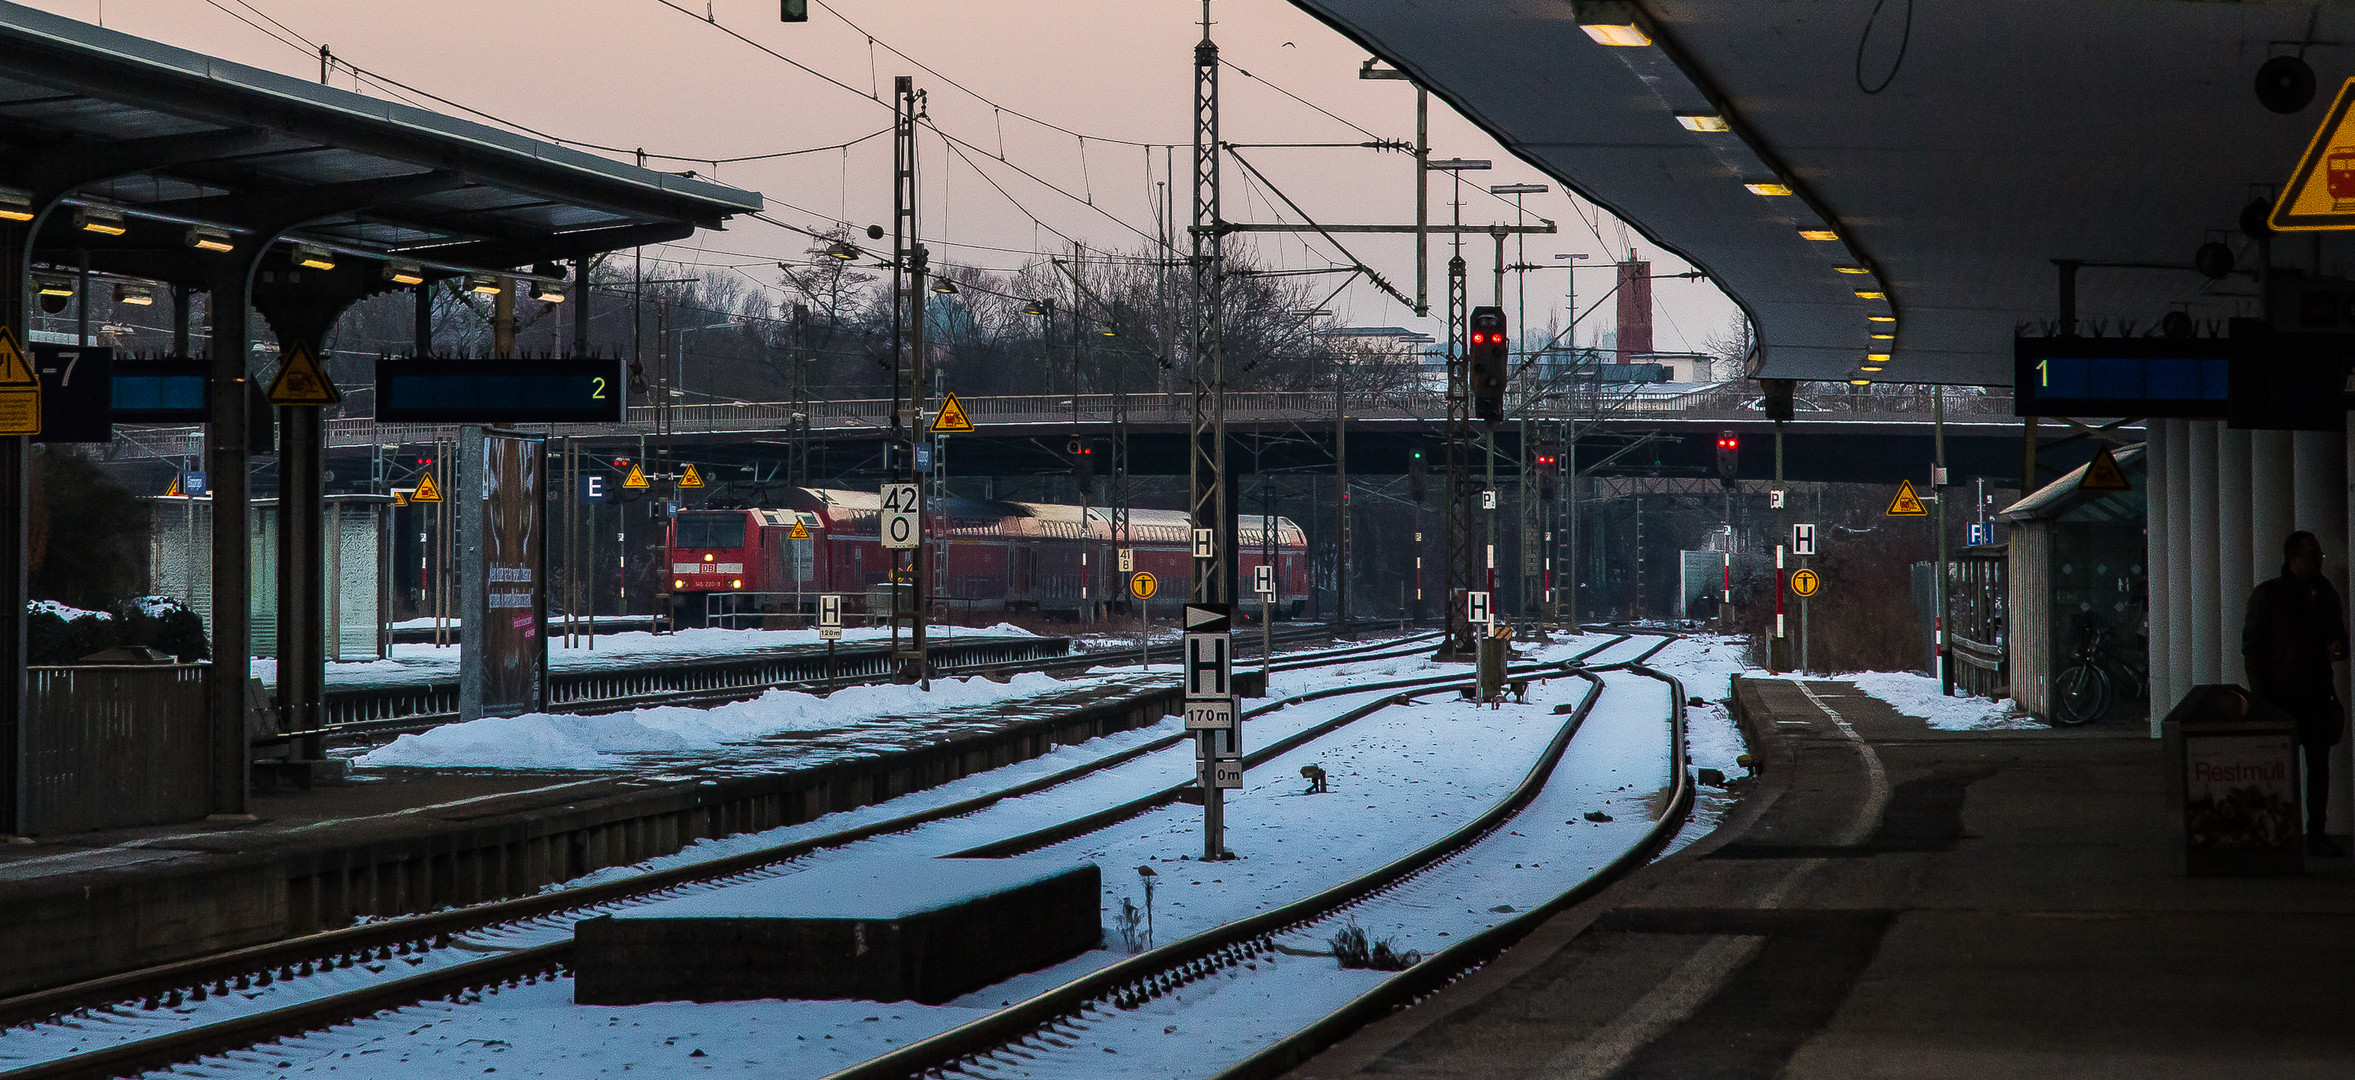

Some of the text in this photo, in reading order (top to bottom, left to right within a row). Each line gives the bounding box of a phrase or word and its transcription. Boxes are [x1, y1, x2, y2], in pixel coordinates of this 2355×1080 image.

[2035, 359, 2049, 388] 1
[592, 377, 606, 399] 2
[588, 476, 603, 497] E
[883, 487, 918, 514] 42
[890, 516, 910, 542] 0
[1796, 525, 1813, 552] H
[1120, 550, 1131, 559] 41
[1195, 530, 1210, 555] H
[702, 564, 715, 573] DB
[1122, 560, 1130, 570] 8
[1256, 567, 1271, 590] H
[823, 597, 838, 623] H
[1471, 594, 1487, 620] H
[1190, 638, 1225, 693] H
[1187, 708, 1230, 722] 170m
[2194, 760, 2287, 782] Restmüll
